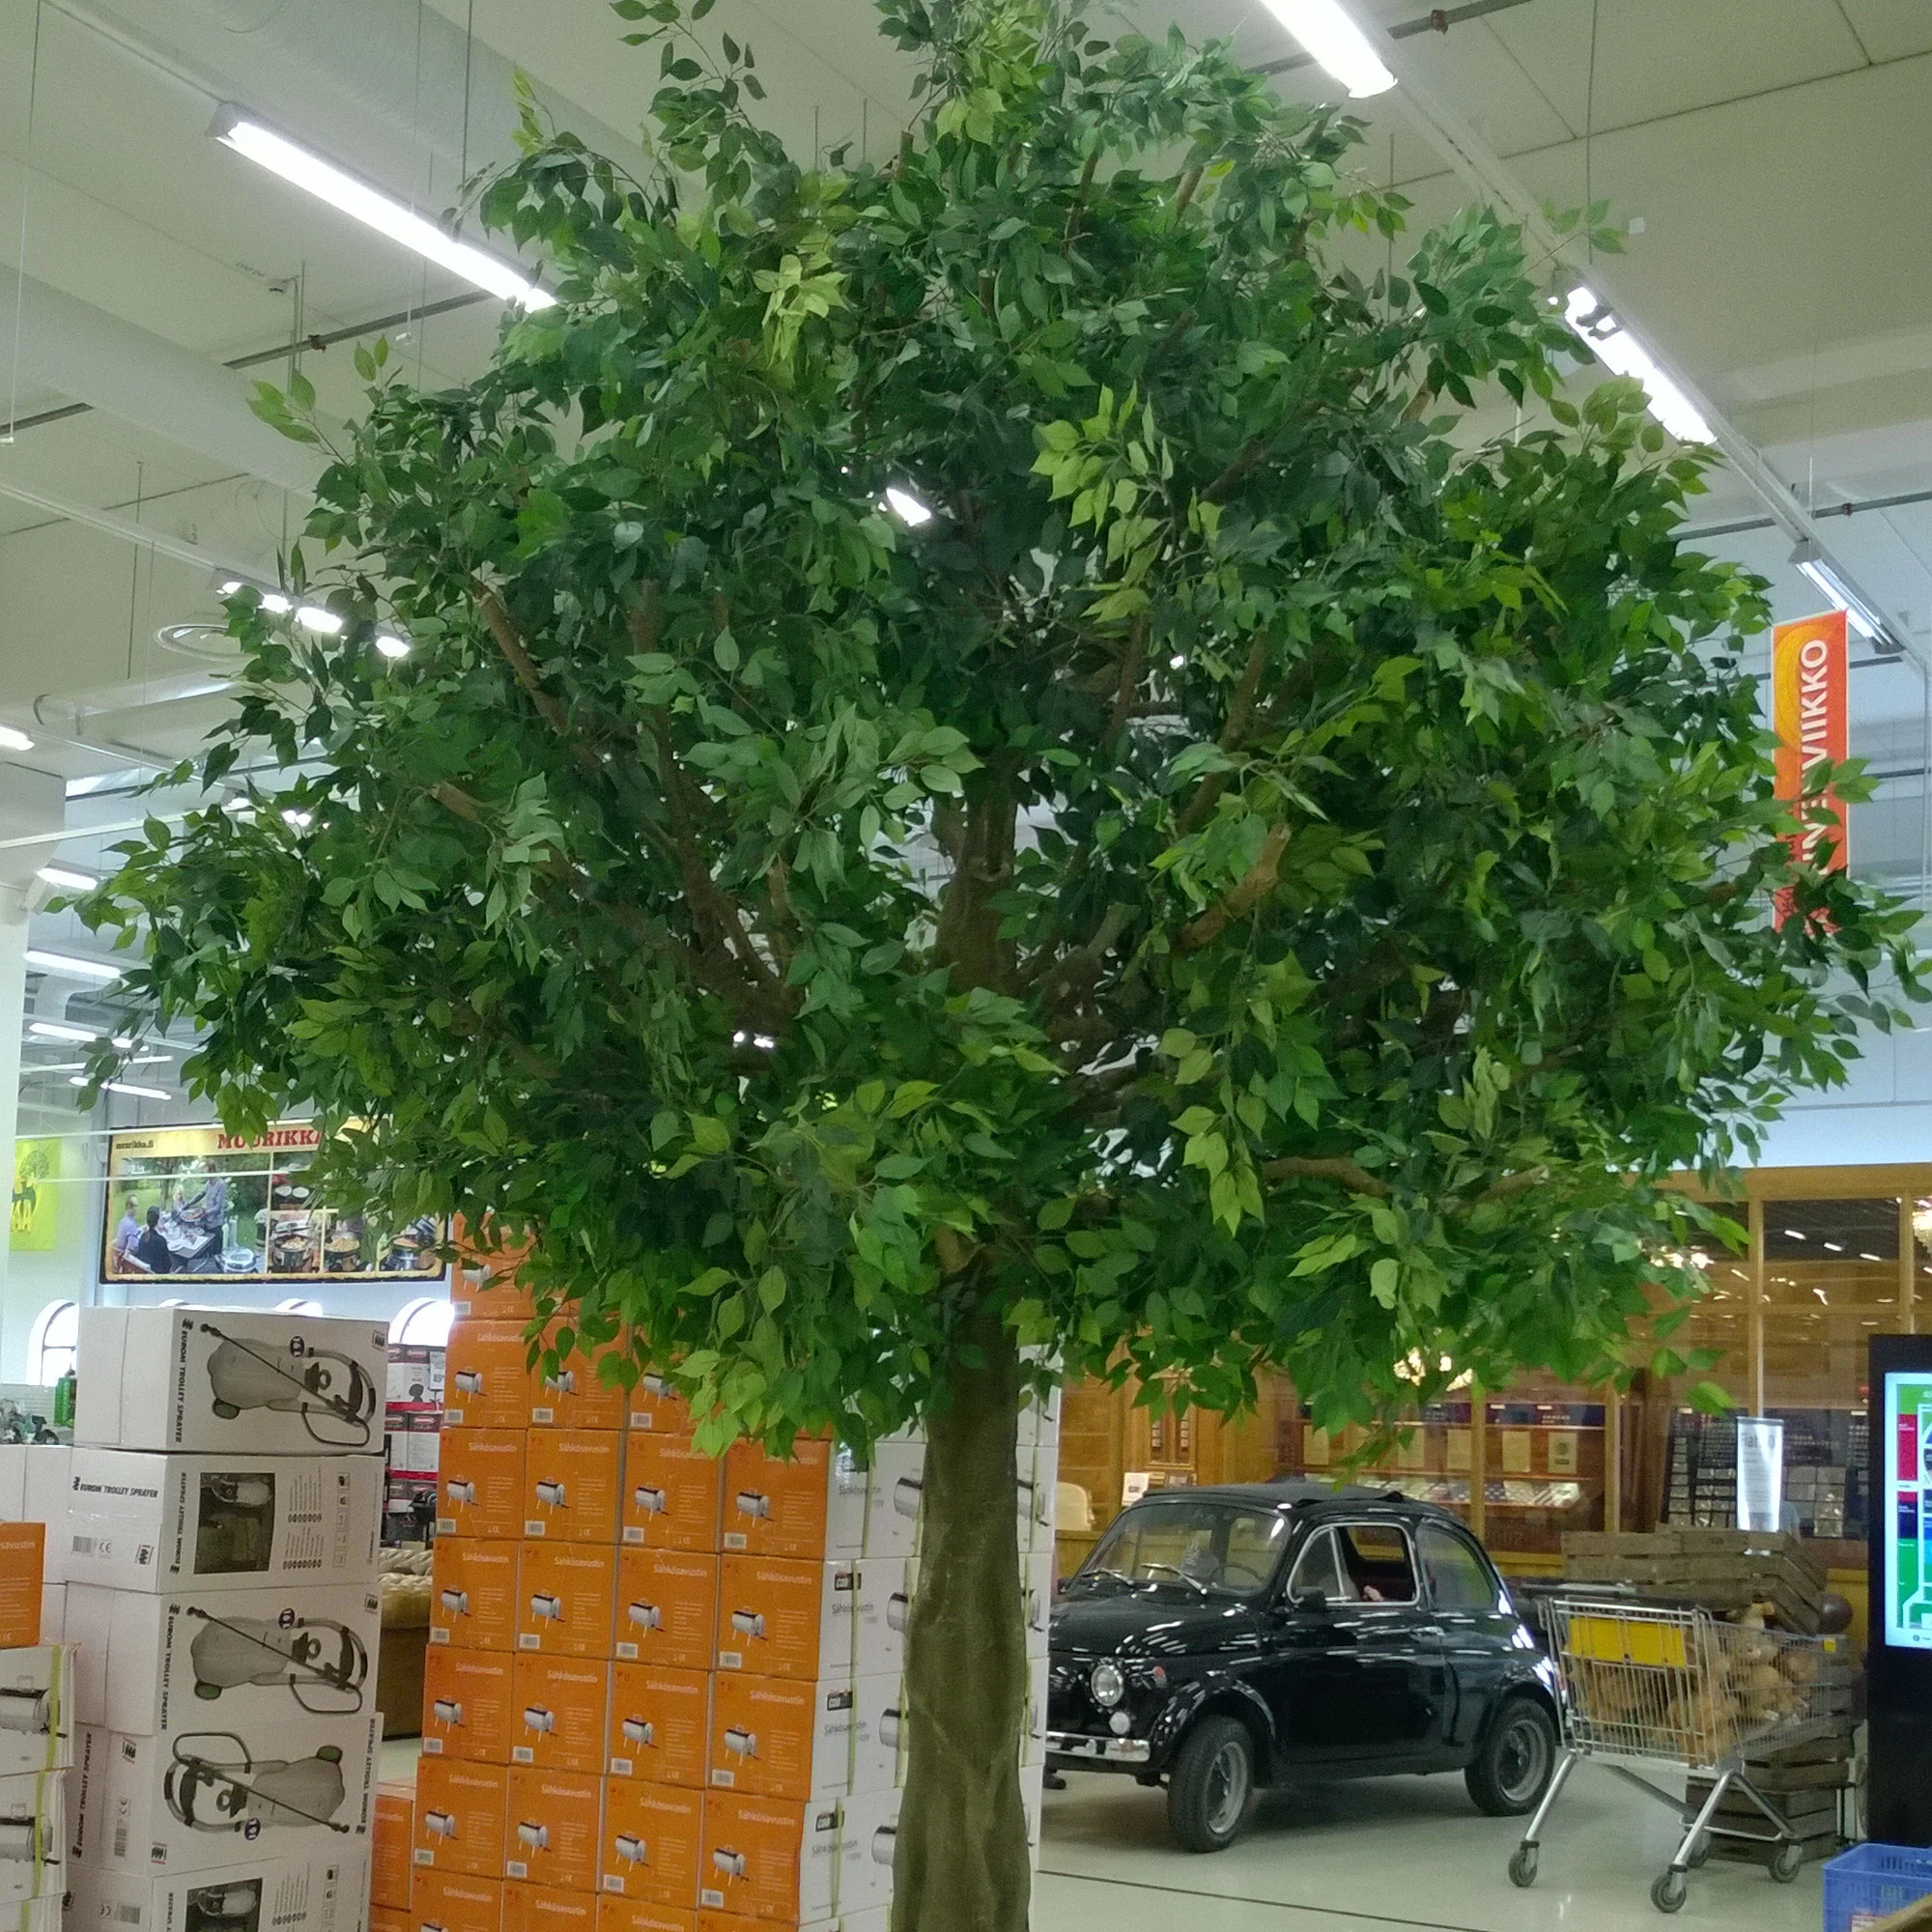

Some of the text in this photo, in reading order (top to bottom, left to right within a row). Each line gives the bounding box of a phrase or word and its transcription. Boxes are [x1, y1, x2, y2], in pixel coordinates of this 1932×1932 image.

[175, 1330, 188, 1443] EUROM TROLLEY SPRAYER
[80, 1483, 158, 1498] EUROM TROLLEY SPRAYER
[160, 1616, 175, 1730] EUROM TROLLEY SPRAYER
[82, 1732, 93, 1772] SPRAYER
[79, 1774, 89, 1810] TROLLEY
